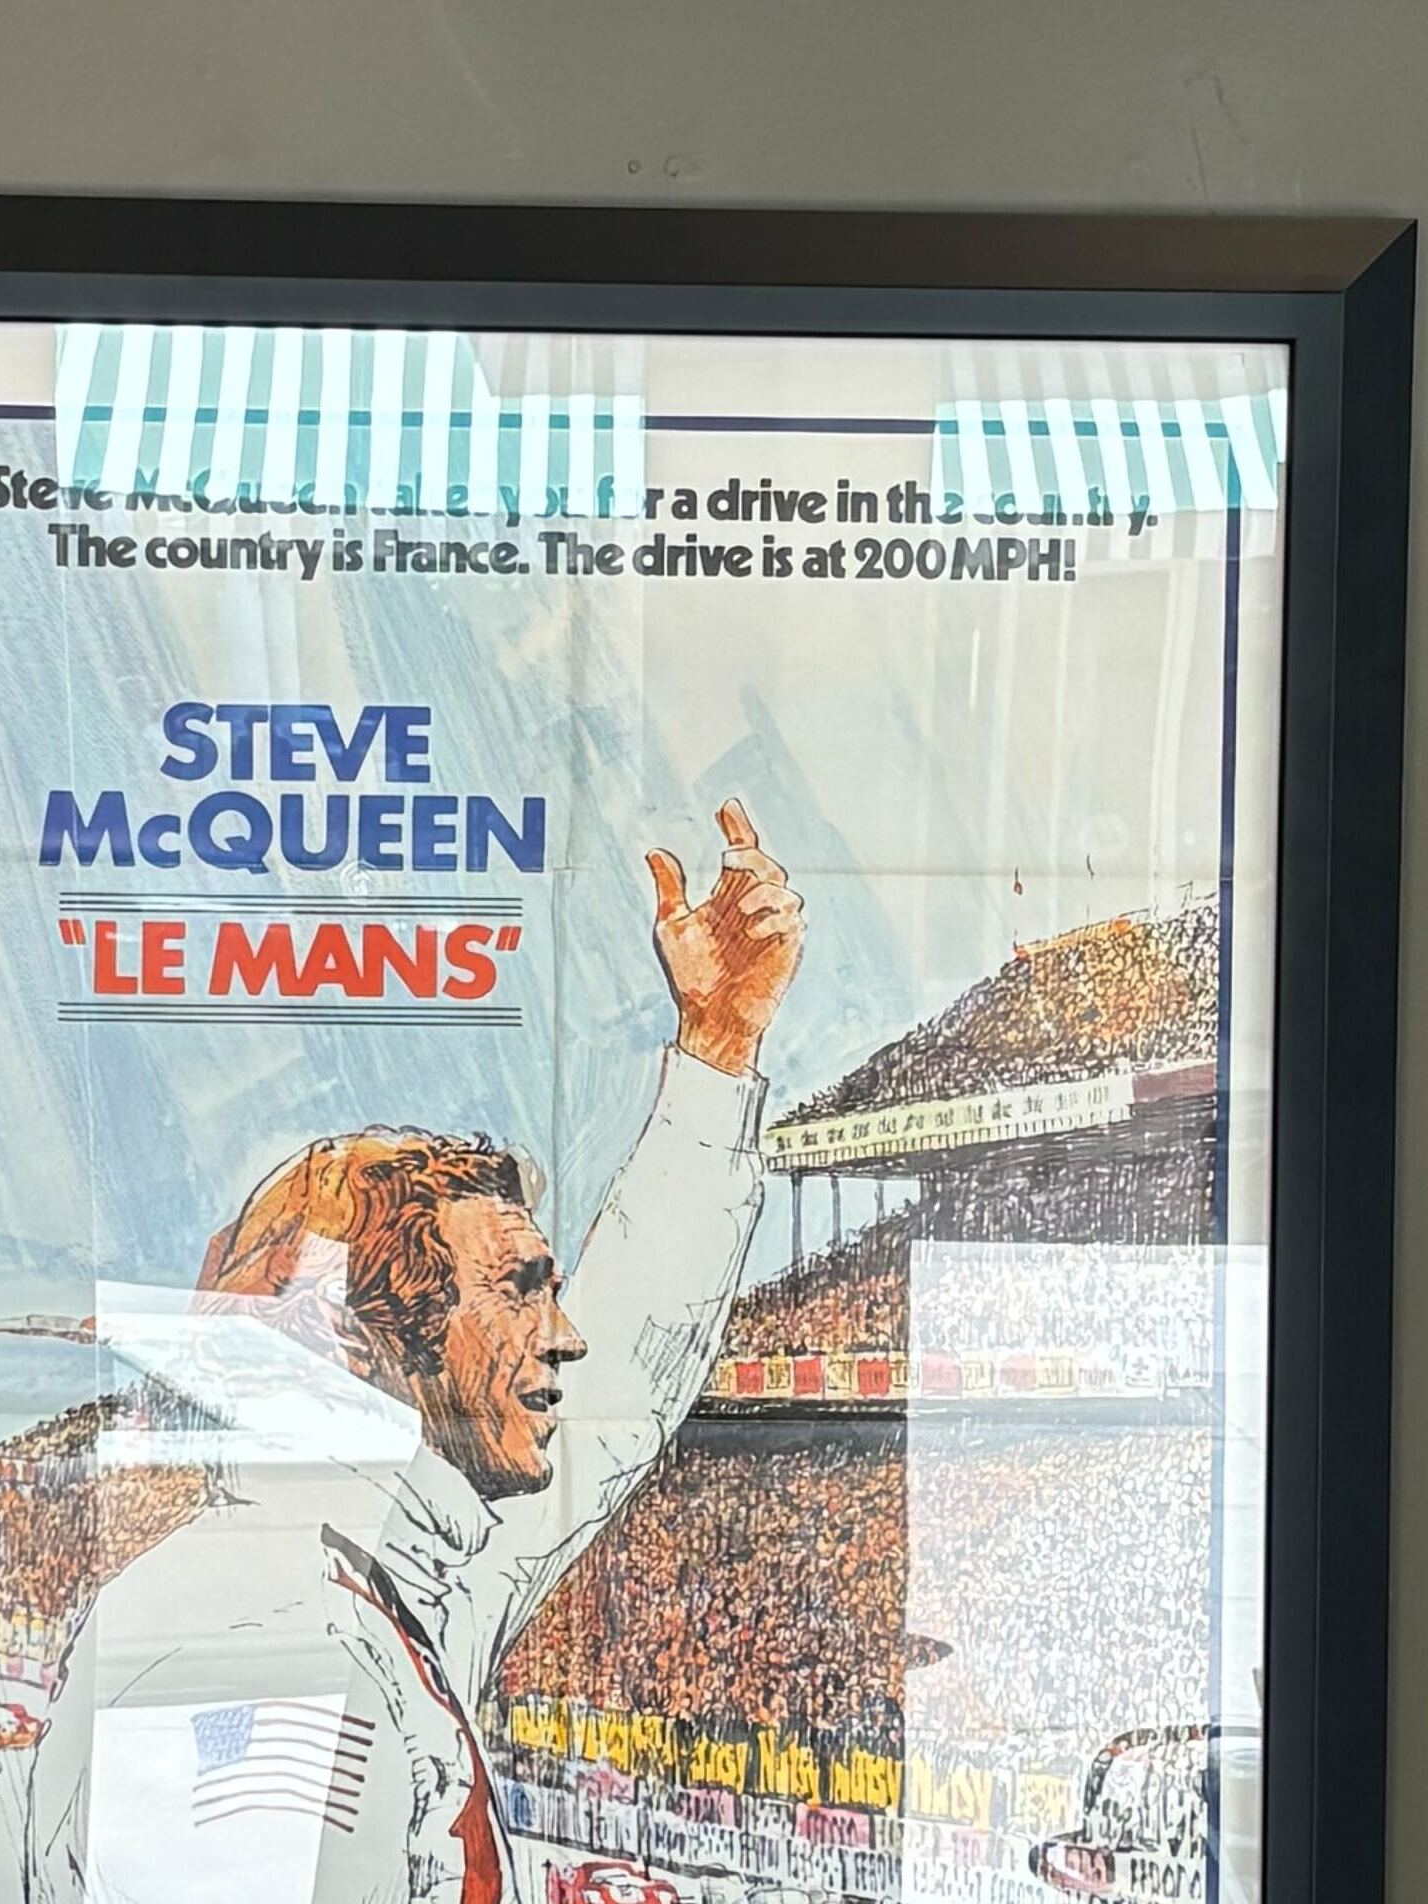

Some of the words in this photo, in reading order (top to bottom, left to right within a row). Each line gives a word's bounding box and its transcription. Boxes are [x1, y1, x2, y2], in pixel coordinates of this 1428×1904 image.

[597, 475, 665, 520] fr
[671, 487, 698, 520] a
[706, 478, 829, 524] drive
[836, 480, 878, 523] in
[886, 480, 964, 524] the
[48, 523, 136, 568] The
[144, 530, 325, 582] country
[332, 529, 364, 572] is
[373, 529, 530, 576] France.
[536, 530, 623, 578] The
[632, 533, 754, 579] drive
[761, 536, 794, 579] is
[802, 539, 847, 579] at
[159, 701, 432, 783] STEVE
[38, 789, 546, 875] McQUEEN
